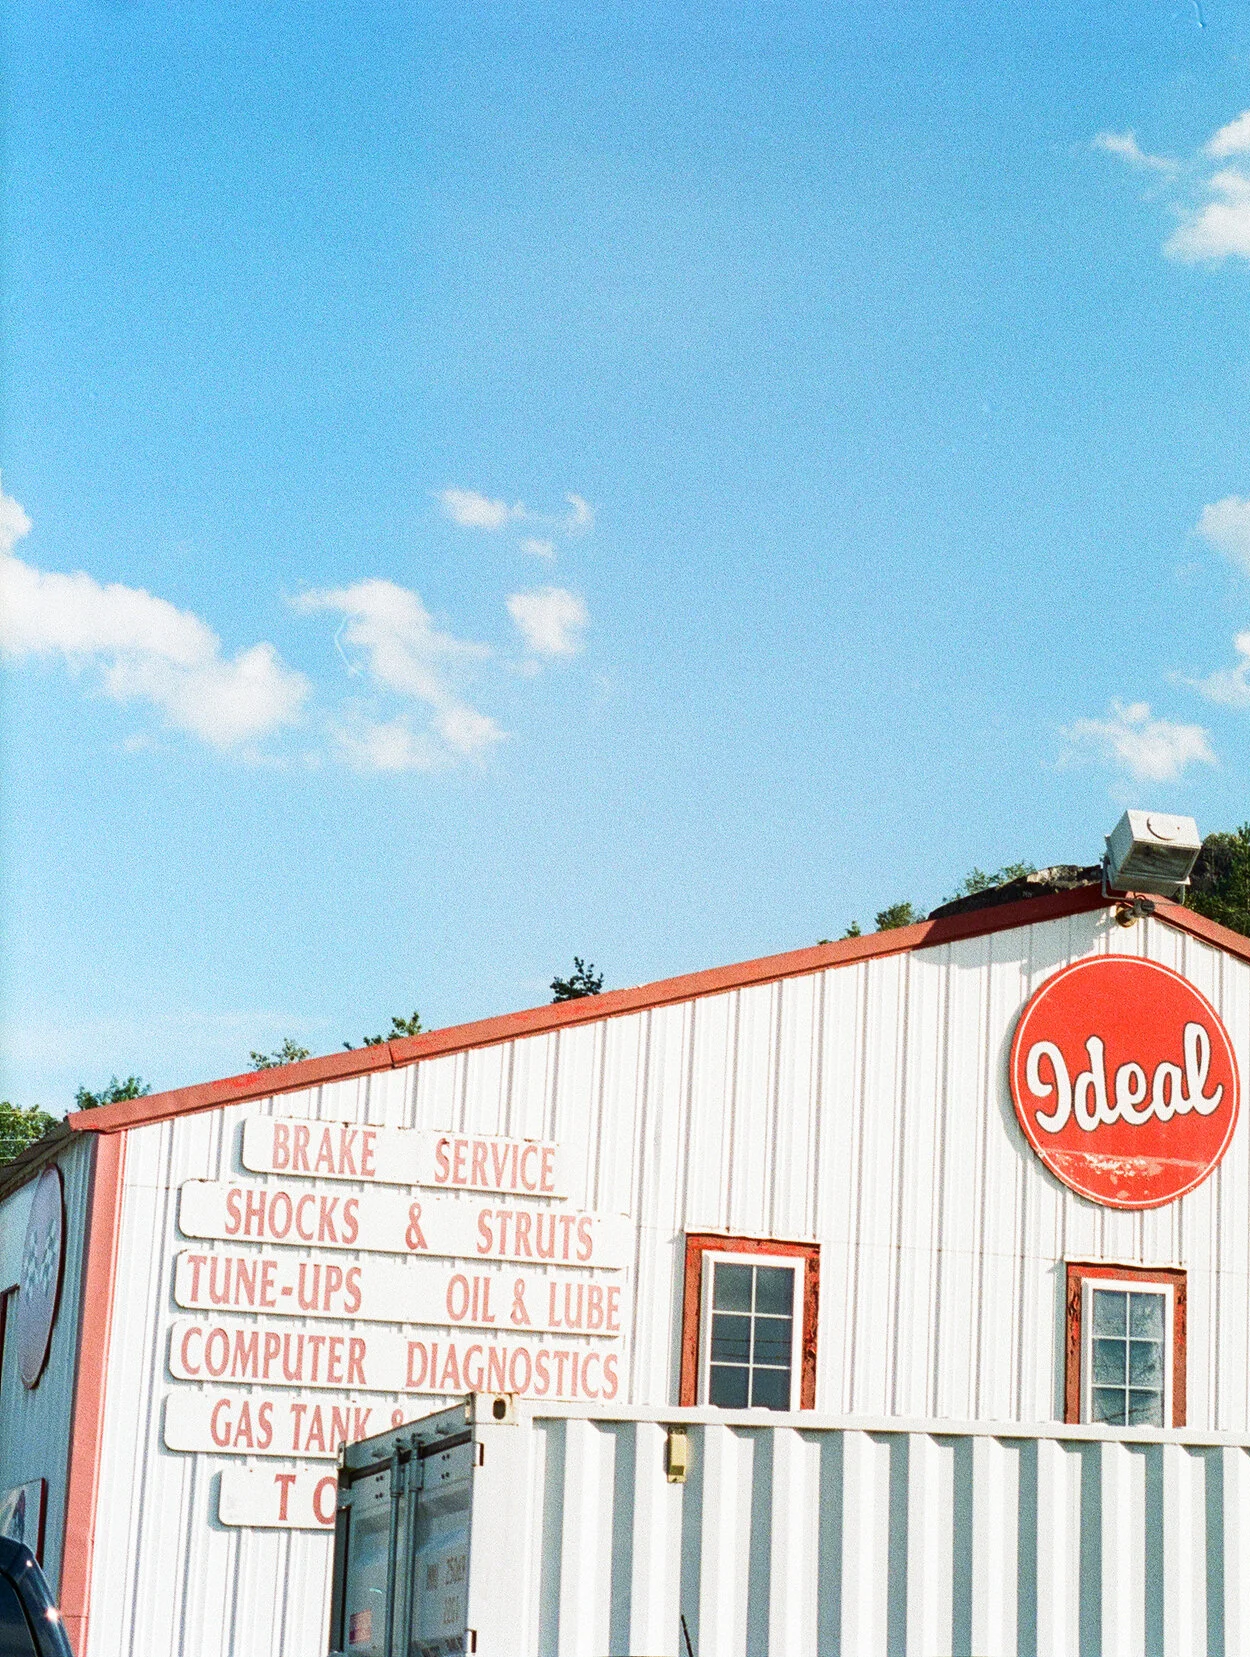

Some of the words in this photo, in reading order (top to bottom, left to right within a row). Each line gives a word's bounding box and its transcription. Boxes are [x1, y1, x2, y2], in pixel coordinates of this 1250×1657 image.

[1025, 1020, 1225, 1134] Ideal
[272, 1123, 377, 1177] BRAKE
[434, 1137, 556, 1193] SERVICE
[224, 1188, 360, 1245] SHOCKS
[405, 1202, 429, 1251] &
[476, 1208, 593, 1262] STRUTS
[187, 1254, 363, 1314] TUNE-UPS
[446, 1273, 496, 1322] OIL
[510, 1278, 531, 1326] &
[548, 1281, 621, 1331] LUBE
[180, 1326, 367, 1385] COMPUTER
[405, 1340, 619, 1400] DIAGNOSTICS
[210, 1398, 274, 1450] GAS
[290, 1402, 373, 1452] TANK
